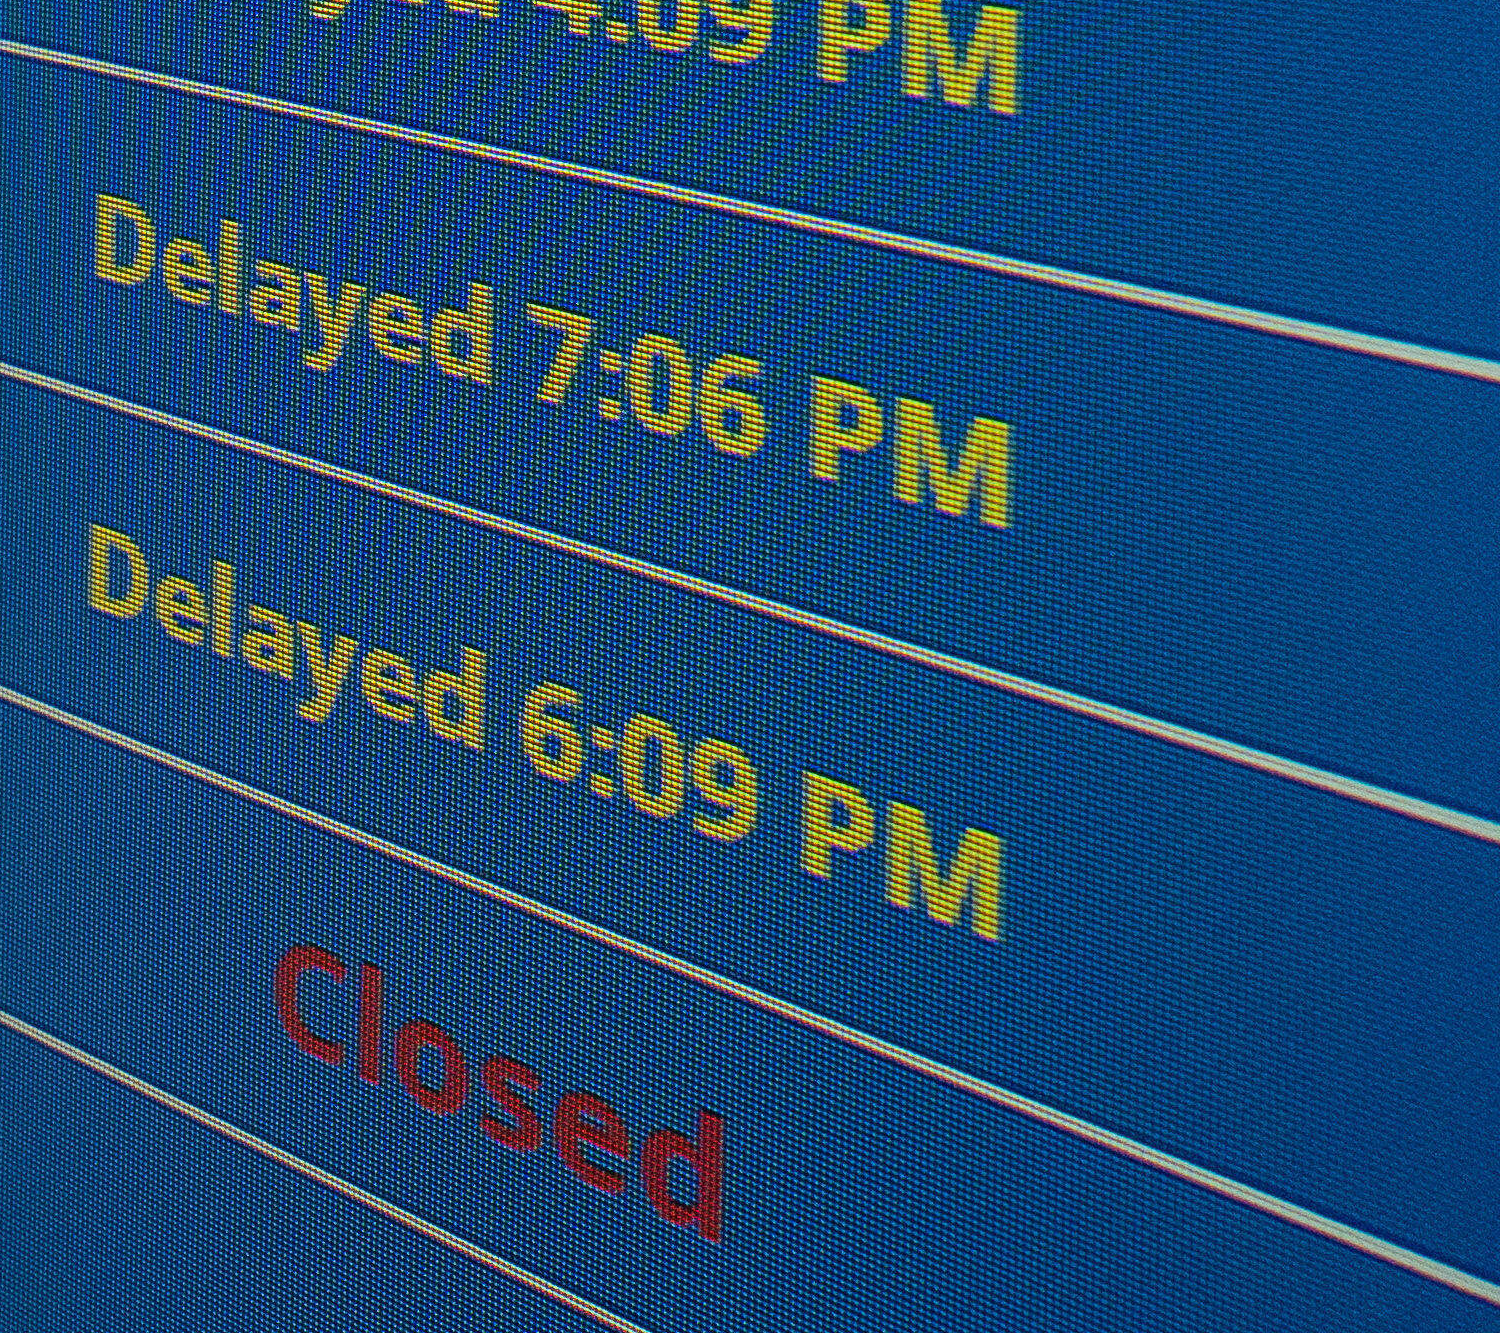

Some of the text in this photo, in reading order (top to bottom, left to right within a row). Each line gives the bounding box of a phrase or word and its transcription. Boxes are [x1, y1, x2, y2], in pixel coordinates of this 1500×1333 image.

[94, 193, 495, 385] Delayed
[526, 302, 767, 459] 7:06
[810, 374, 1015, 531] PM
[87, 523, 488, 752] Delayed
[520, 680, 758, 842] 6:09
[801, 770, 1007, 944] PM
[271, 944, 725, 1244] Closed
